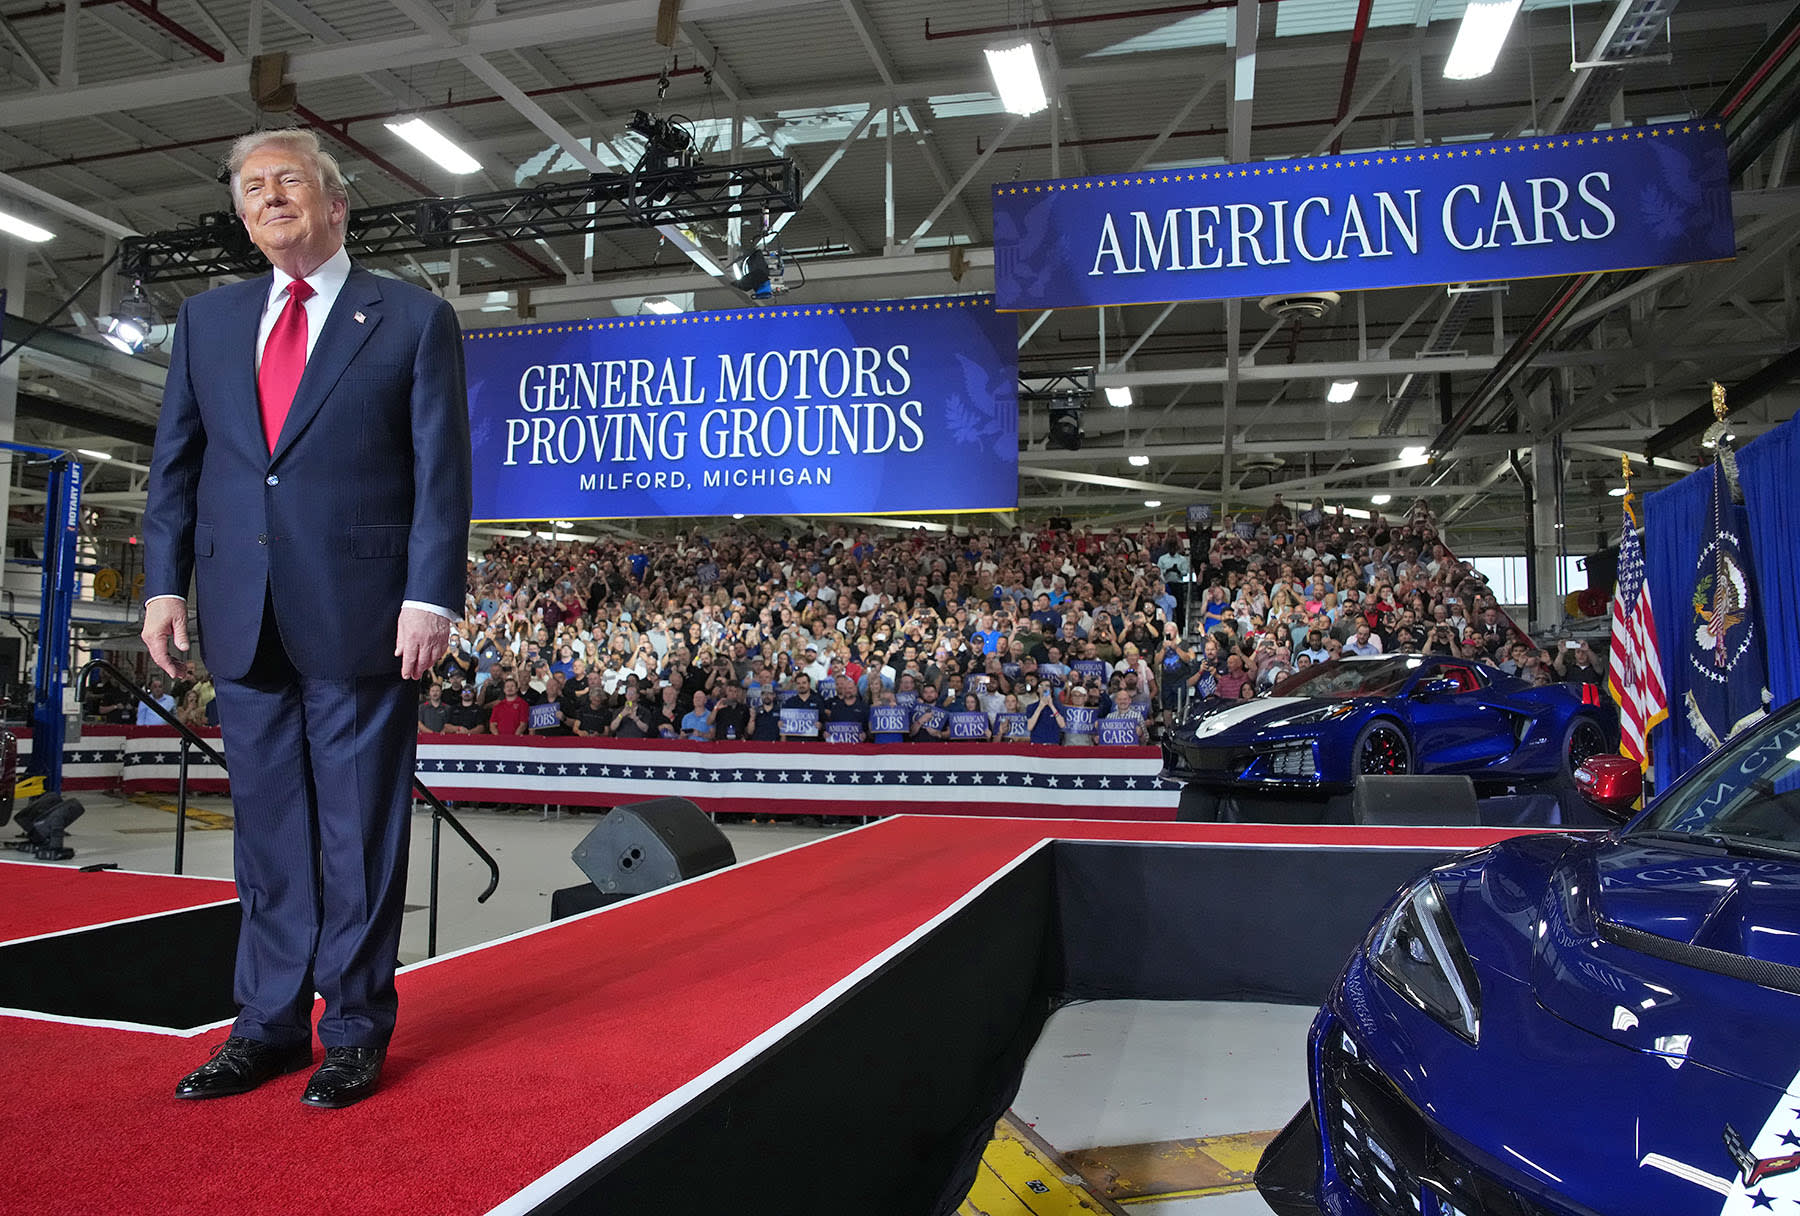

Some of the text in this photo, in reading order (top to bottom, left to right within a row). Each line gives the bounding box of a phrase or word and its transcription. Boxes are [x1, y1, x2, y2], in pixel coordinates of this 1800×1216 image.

[1088, 171, 1616, 277] AMERICAN CARS
[519, 344, 912, 413] GENERAL MOTORS
[503, 400, 925, 466] PROVING GROUNDS
[579, 467, 832, 494] MILFORD, MICHIGAN
[68, 463, 81, 526] ROTARY LIFT
[873, 708, 905, 716] AMERICAN
[953, 714, 985, 723] AMERICAN
[532, 712, 556, 728] JOBS
[784, 719, 813, 733] JOBS
[875, 716, 904, 730] JOBS
[1101, 722, 1135, 730] AMERICAN
[828, 725, 860, 733] AMERICAN
[954, 723, 985, 737] CARS
[1102, 729, 1135, 744] CARS
